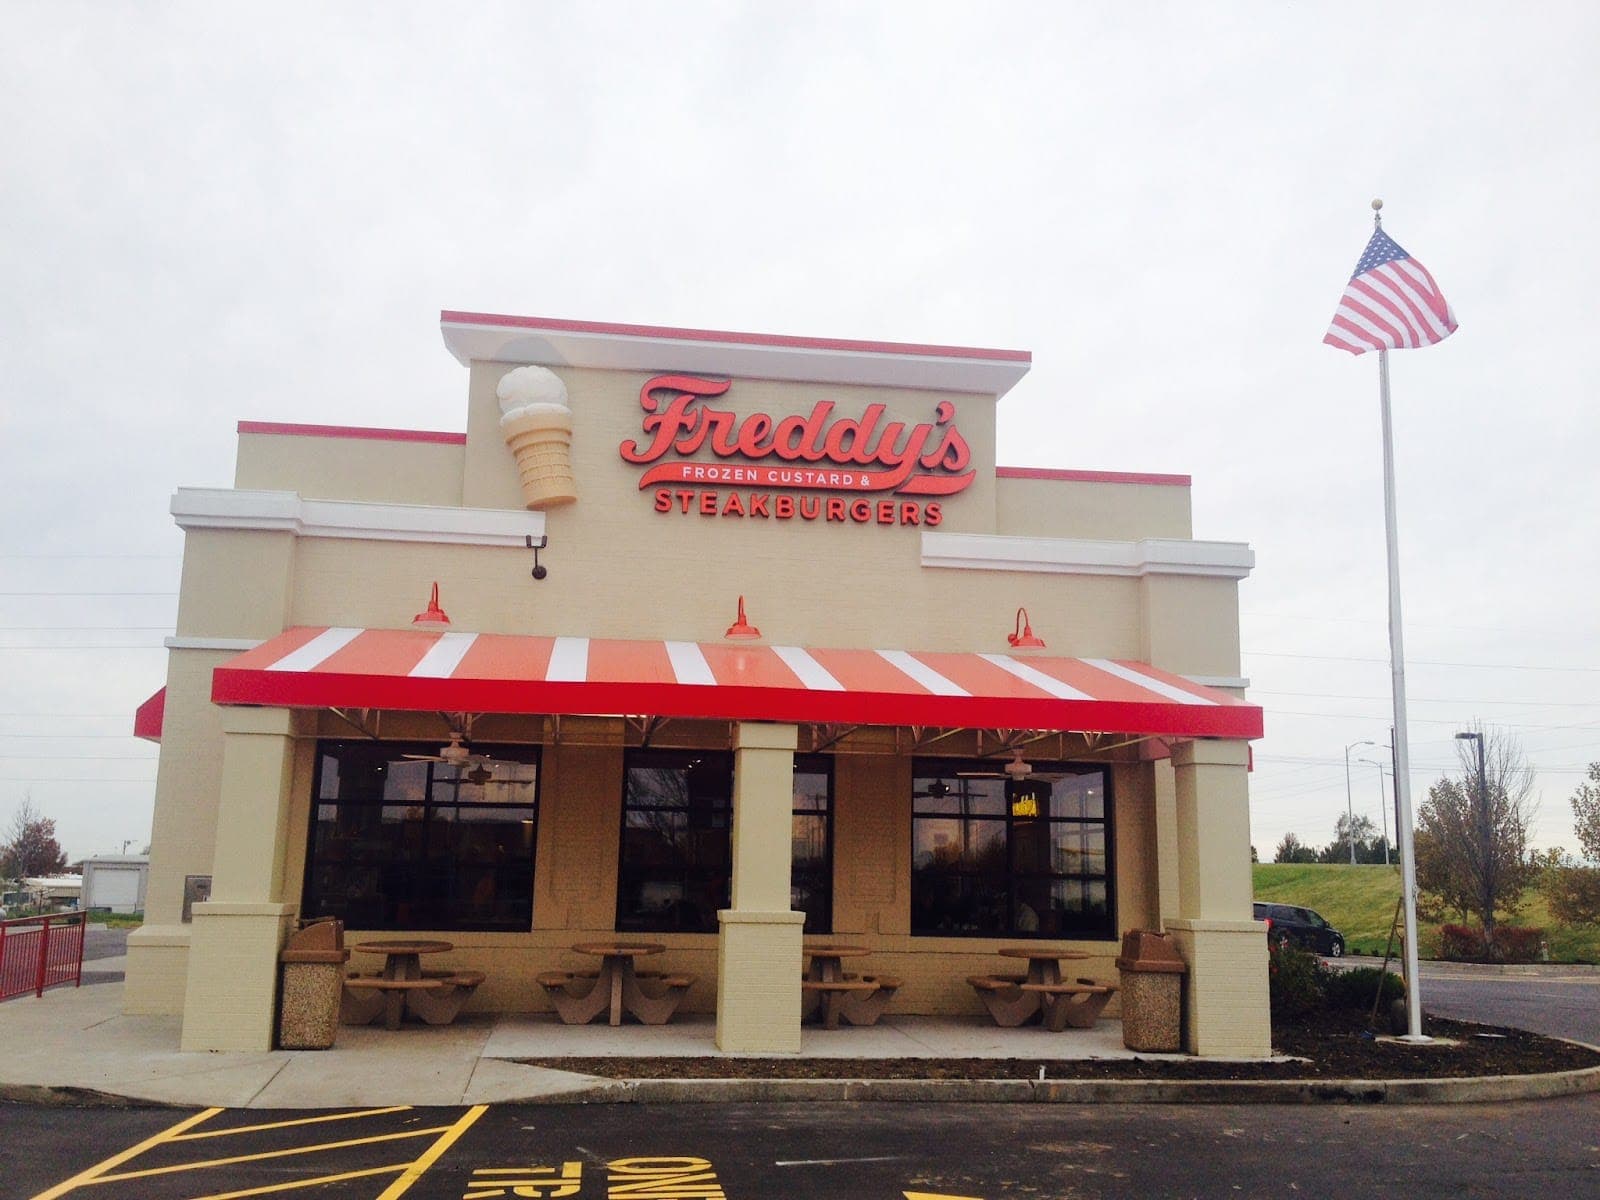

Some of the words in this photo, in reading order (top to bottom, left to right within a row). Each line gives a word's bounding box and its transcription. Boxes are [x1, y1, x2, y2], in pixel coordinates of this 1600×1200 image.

[619, 374, 972, 484] Freddy's
[682, 465, 758, 481] FROZEN
[768, 470, 853, 486] CUSTARD
[860, 474, 870, 487] &
[654, 487, 943, 526] STEAKBURGERS
[607, 1156, 727, 1200] ON
